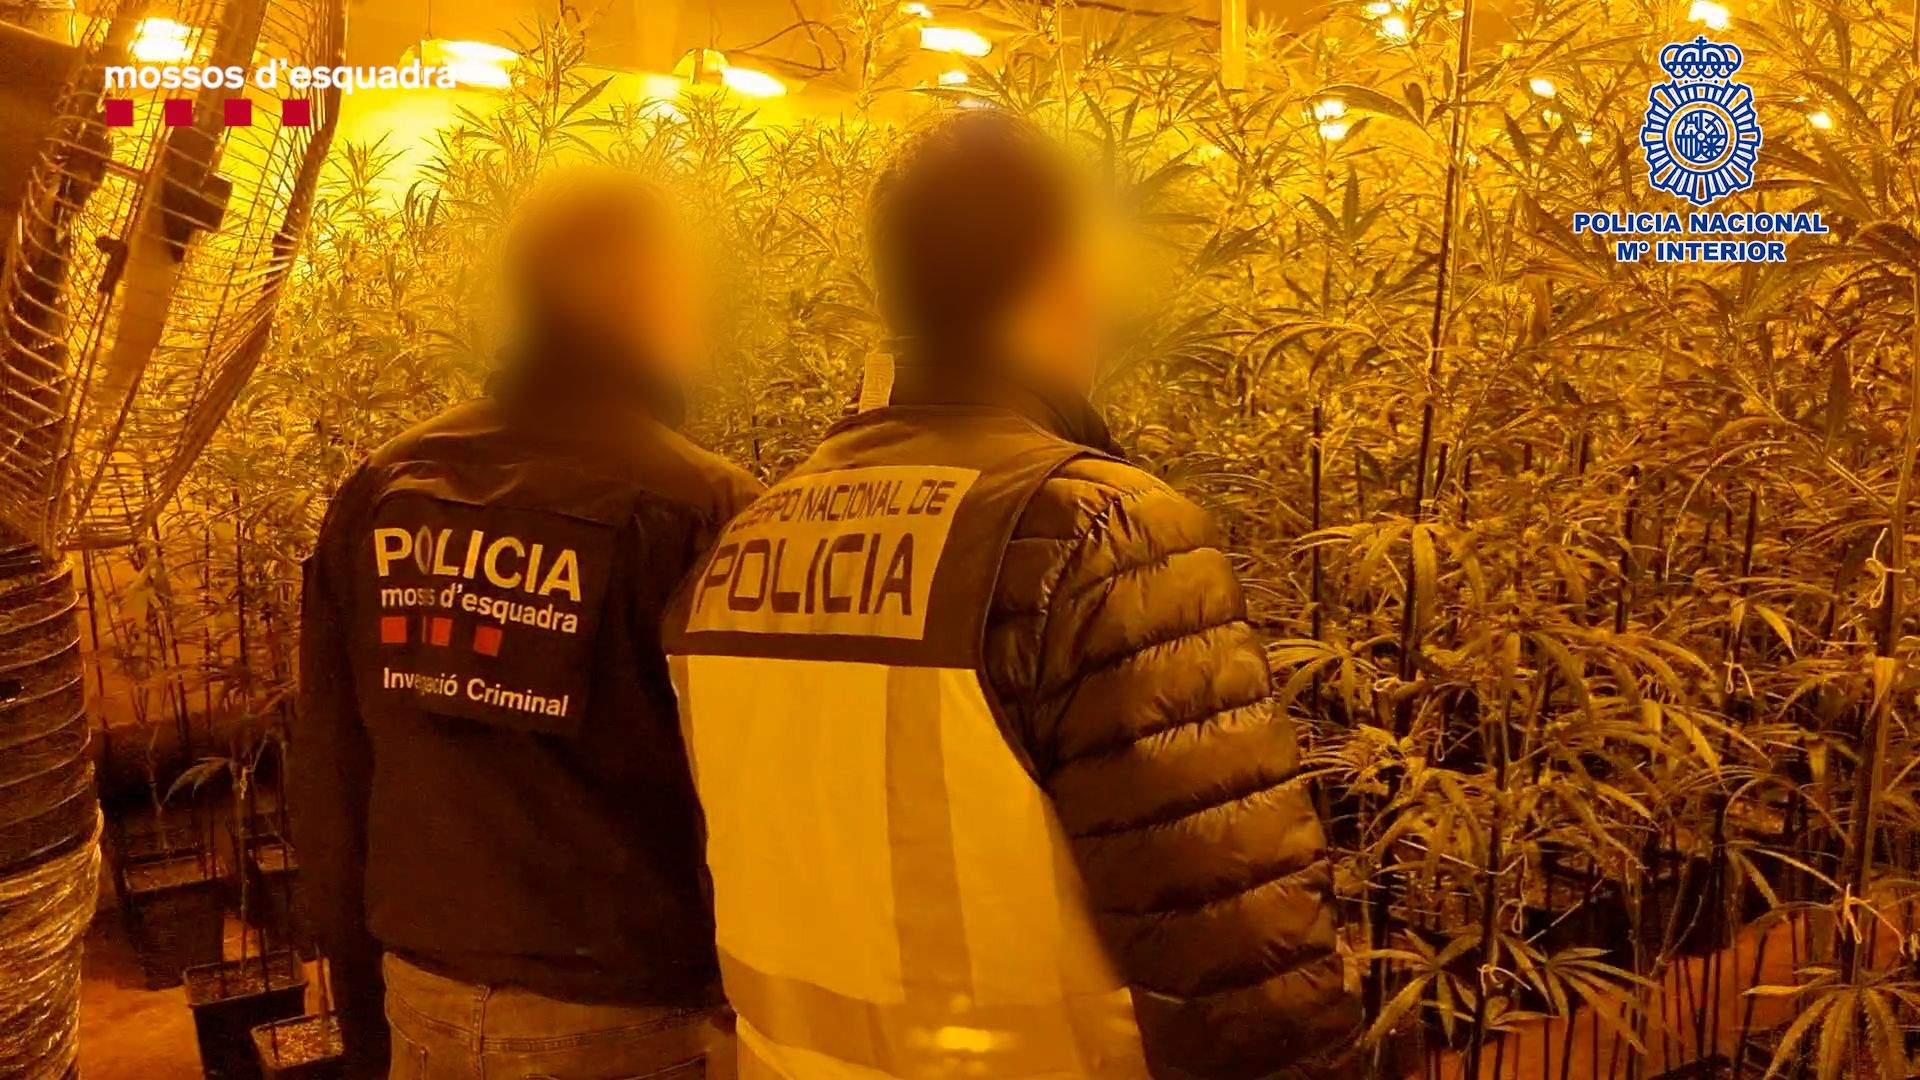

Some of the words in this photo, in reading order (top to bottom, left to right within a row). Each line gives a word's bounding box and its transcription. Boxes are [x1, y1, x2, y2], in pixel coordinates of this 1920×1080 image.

[803, 480, 902, 522] NACIONAL
[907, 480, 957, 515] DE
[373, 525, 582, 602] POLICIA
[696, 532, 914, 615] POLICIA
[466, 677, 569, 717] Criminal
